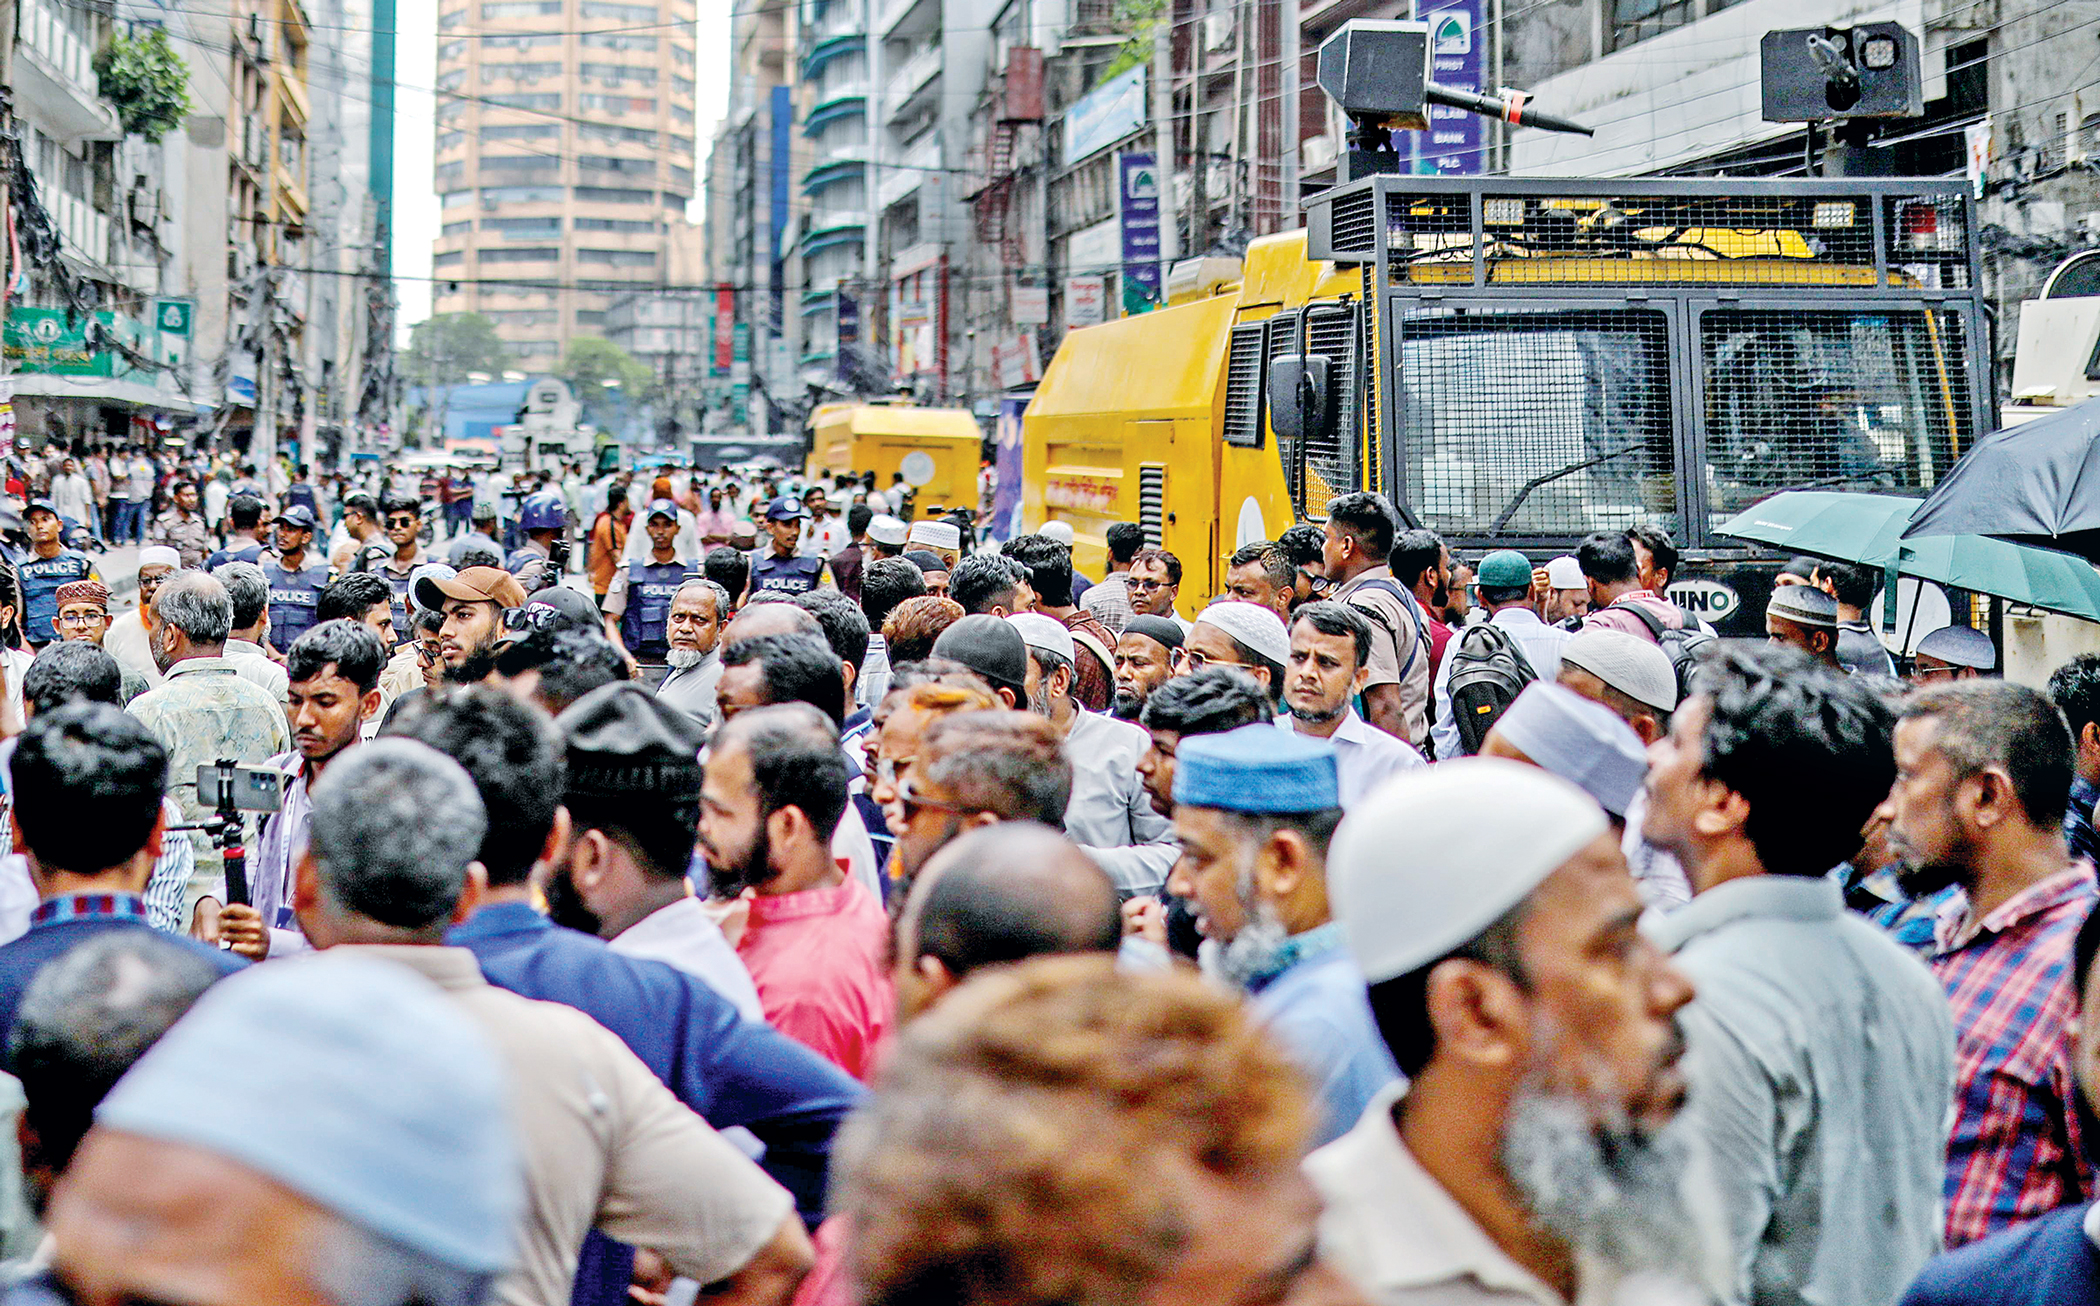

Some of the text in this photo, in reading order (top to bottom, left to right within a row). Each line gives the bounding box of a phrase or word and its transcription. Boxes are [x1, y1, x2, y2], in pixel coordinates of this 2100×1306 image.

[1433, 131, 1465, 144] BANK
[1438, 156, 1461, 169] PLC
[22, 561, 79, 578] POLICE
[642, 584, 678, 596] POLIC
[763, 578, 808, 590] POLICE
[271, 590, 311, 603] POLICE
